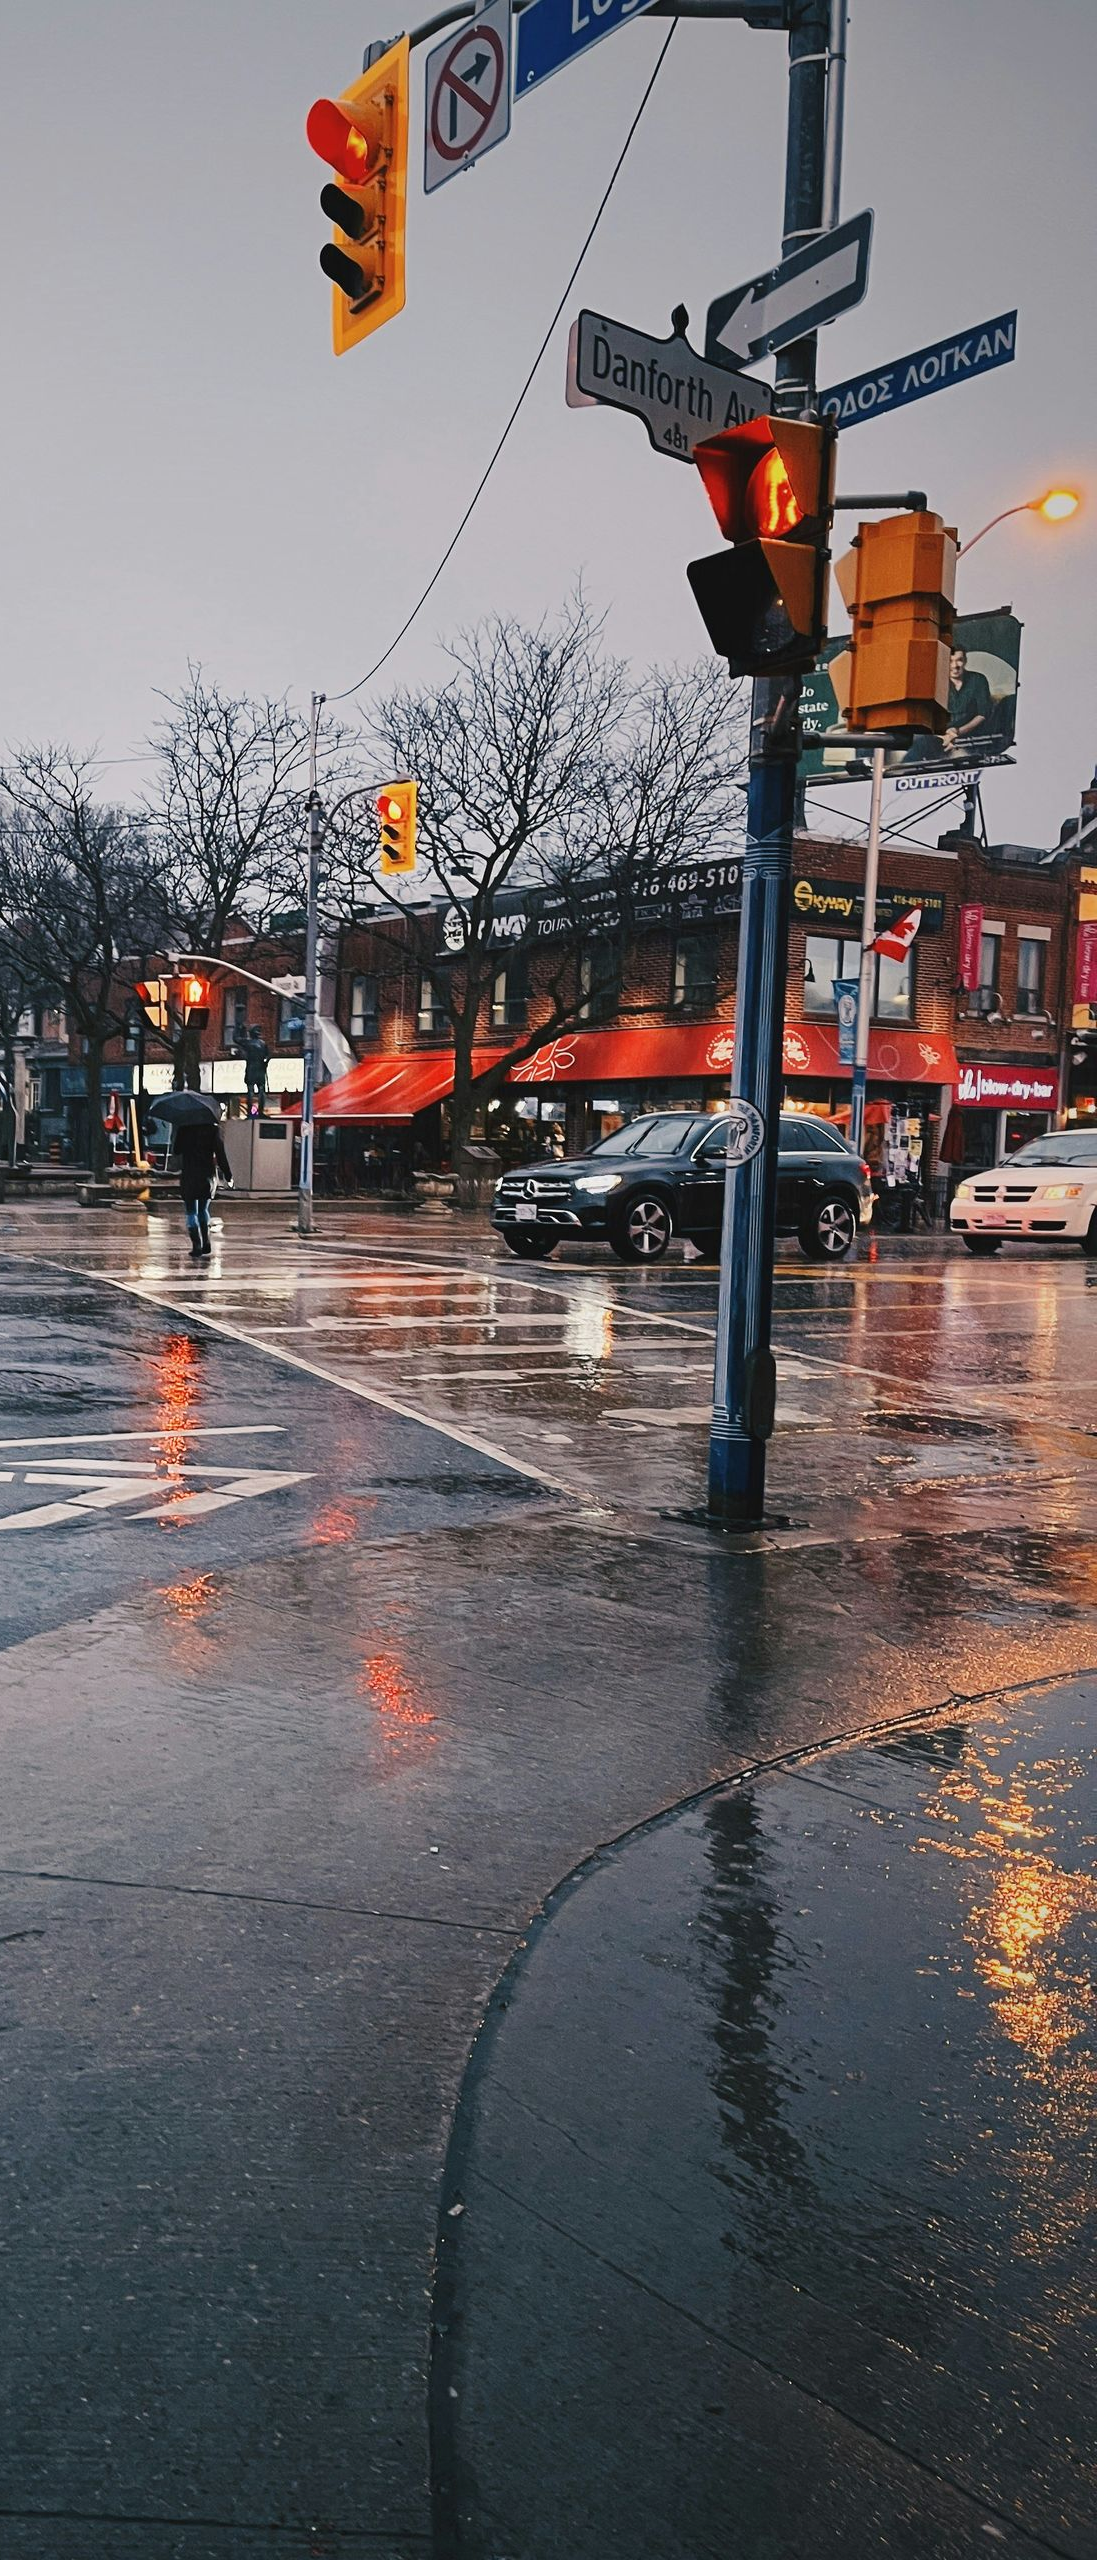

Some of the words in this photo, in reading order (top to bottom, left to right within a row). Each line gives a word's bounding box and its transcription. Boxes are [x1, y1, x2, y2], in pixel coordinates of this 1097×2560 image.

[593, 335, 712, 422] Danforth
[902, 323, 1014, 393] ΛΟΓΚΑΝ
[663, 428, 688, 451] 481
[897, 771, 979, 791] OUTFRONT
